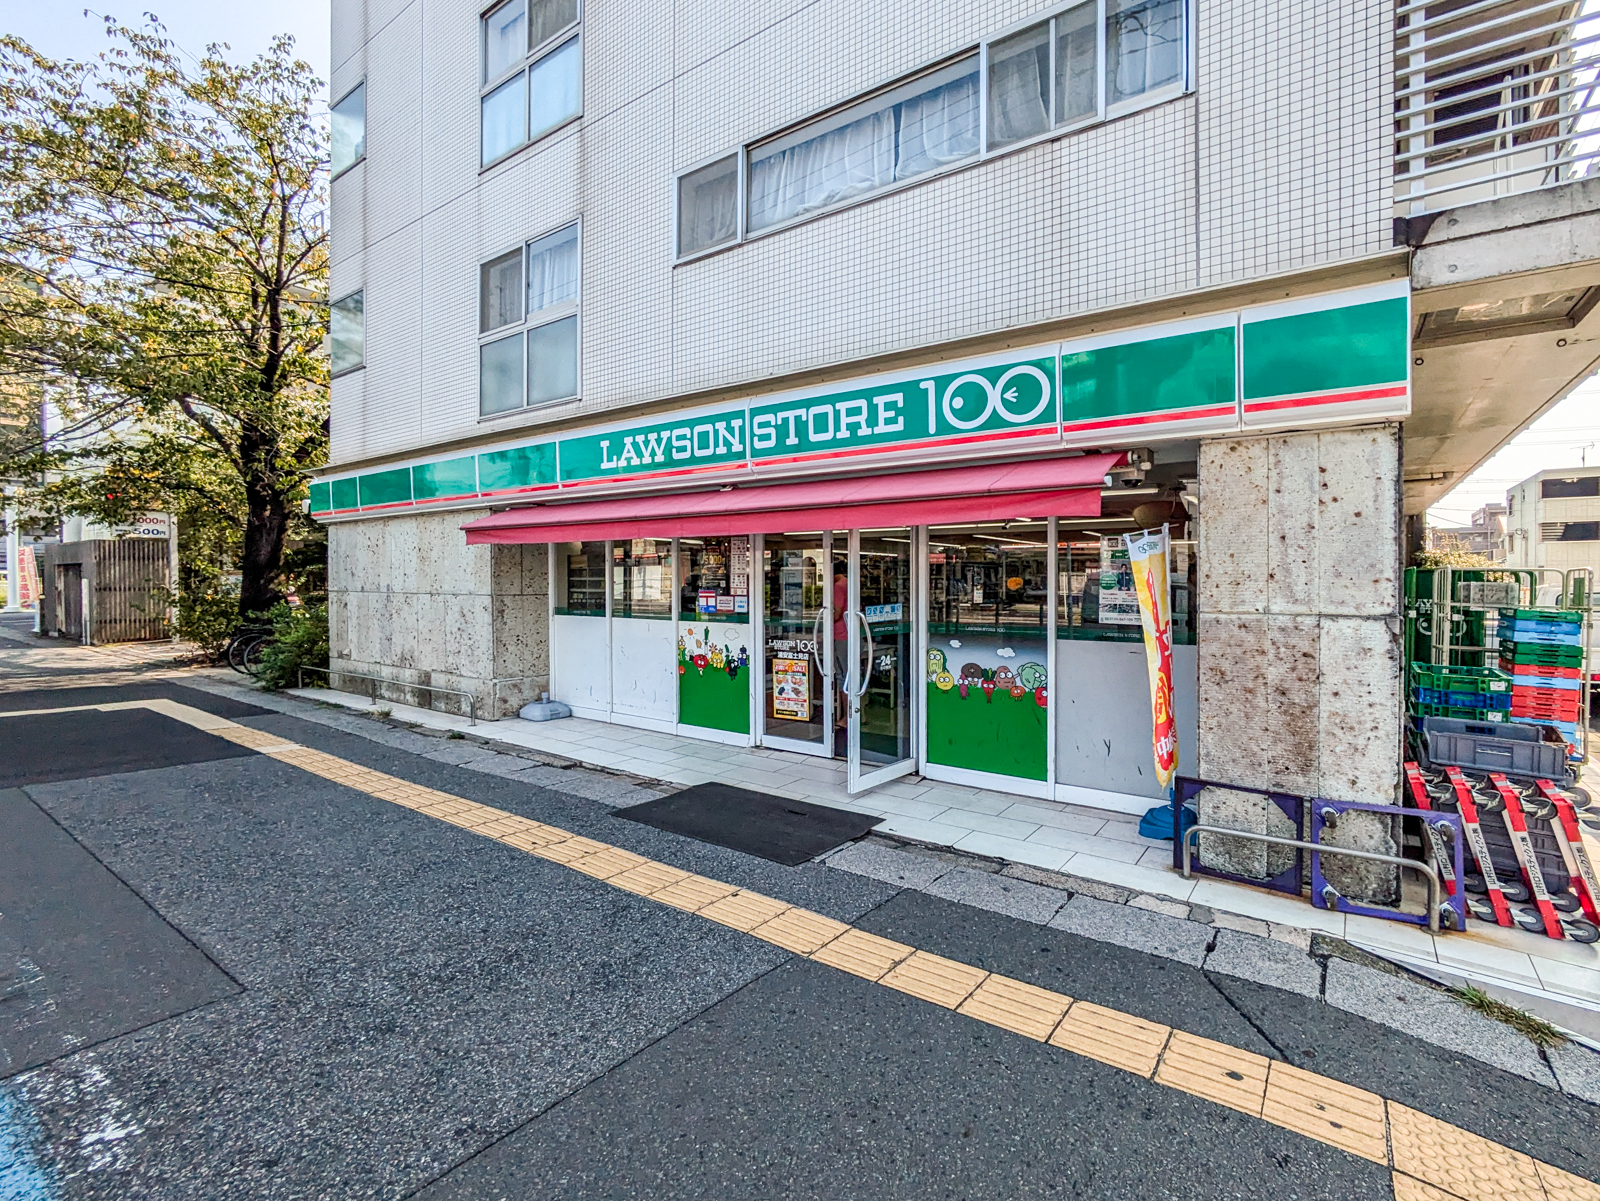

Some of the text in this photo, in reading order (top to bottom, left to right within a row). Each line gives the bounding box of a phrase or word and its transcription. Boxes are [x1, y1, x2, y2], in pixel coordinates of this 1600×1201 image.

[600, 365, 1051, 469] LAWSON STORE 100
[768, 639, 796, 647] LAWSON
